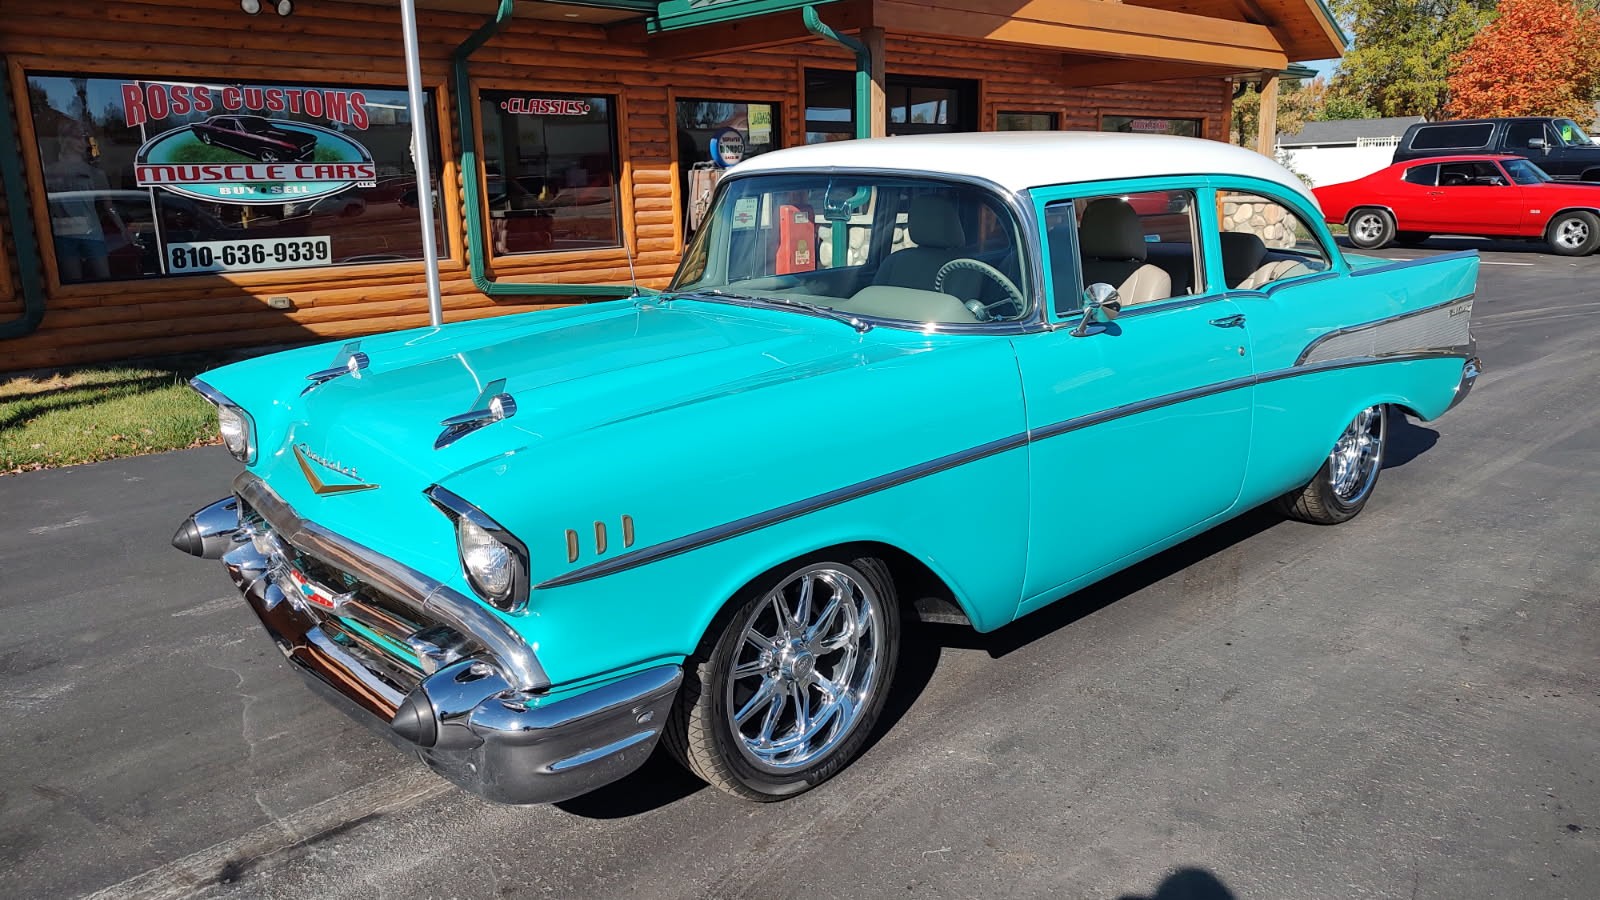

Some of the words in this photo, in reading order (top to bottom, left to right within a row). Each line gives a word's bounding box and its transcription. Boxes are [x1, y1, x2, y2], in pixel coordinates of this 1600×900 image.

[121, 83, 213, 128] ROSS
[221, 86, 369, 130] CUSTOMS
[508, 98, 584, 115] CLASSICS
[137, 165, 285, 182] MUSCLE
[295, 164, 375, 180] CARS
[219, 186, 256, 195] BUY
[270, 185, 310, 194] SELL
[172, 241, 328, 269] 810-636-9339
